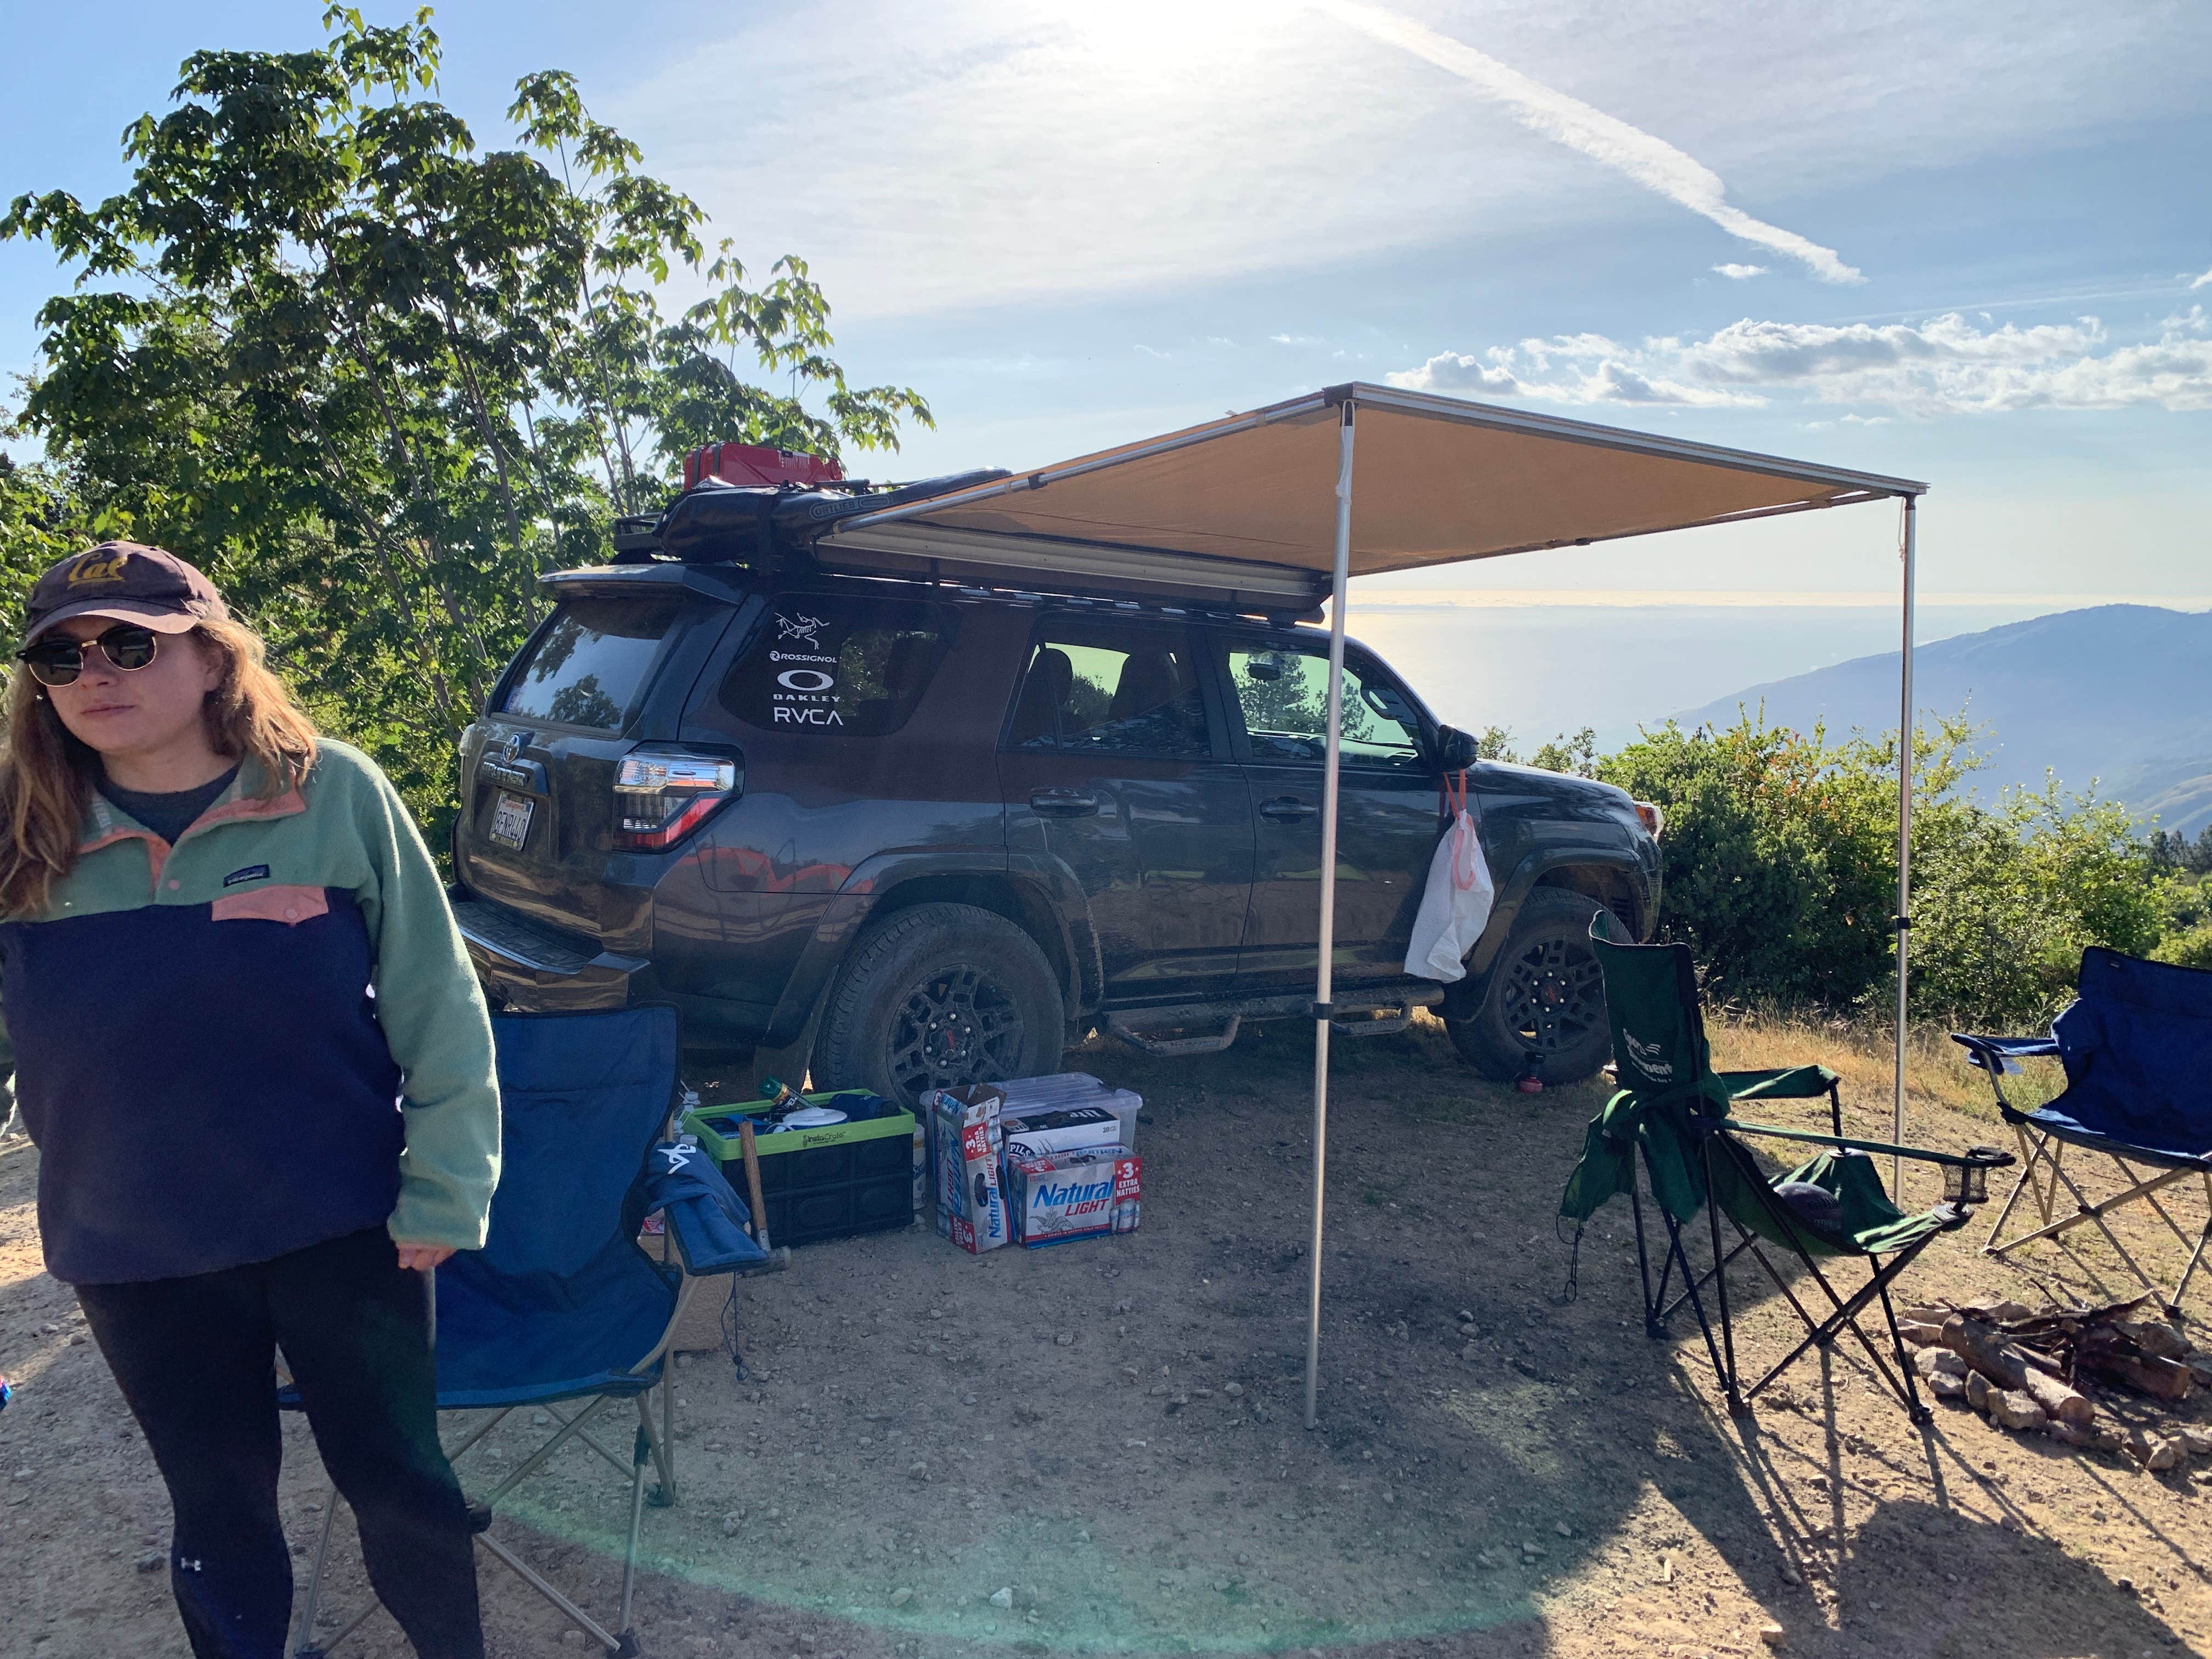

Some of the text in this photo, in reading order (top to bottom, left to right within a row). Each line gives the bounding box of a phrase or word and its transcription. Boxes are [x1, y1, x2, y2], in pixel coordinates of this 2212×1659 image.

[815, 501, 854, 515] ORTLIEB
[69, 552, 127, 582] Cal
[781, 653, 837, 663] ROSSIGNOL
[773, 693, 840, 702] OAKLEY
[774, 707, 844, 726] RVCA
[966, 1139, 975, 1150] 3
[1011, 1144, 1034, 1157] PILS
[1122, 1162, 1134, 1179] 3
[1119, 1178, 1138, 1188] EXTRA
[986, 1158, 1001, 1238] Natural LIGHT
[1032, 1174, 1116, 1209] Natural
[1116, 1185, 1140, 1198] NATTIES
[1064, 1198, 1109, 1217] LIGHT
